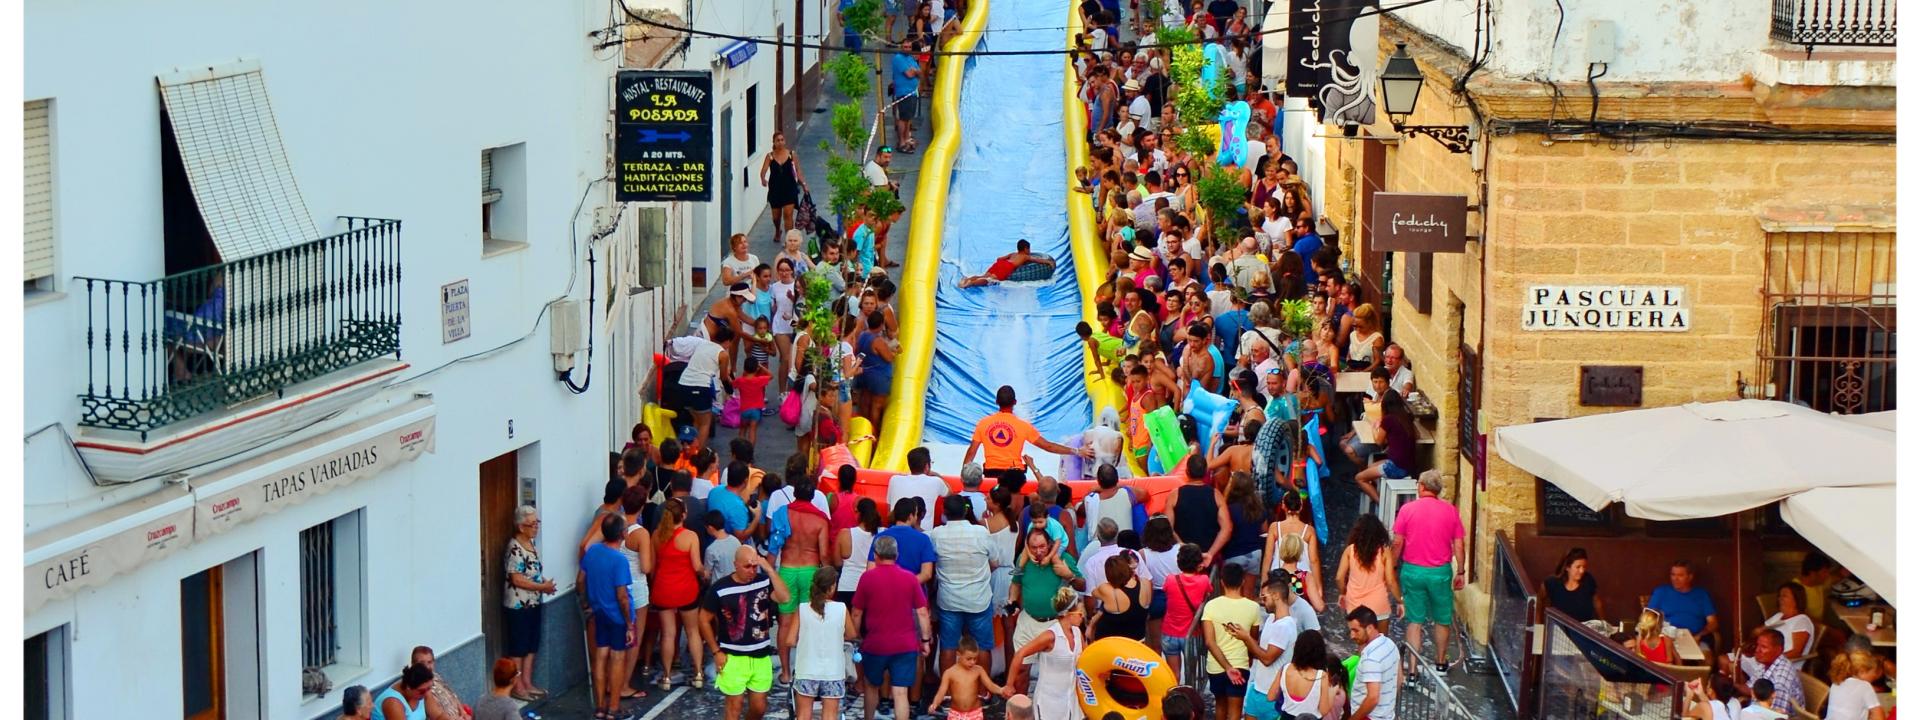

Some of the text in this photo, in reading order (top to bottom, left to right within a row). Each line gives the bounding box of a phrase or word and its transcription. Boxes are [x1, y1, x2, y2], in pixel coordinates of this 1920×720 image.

[622, 78, 706, 103] HOSTAL RESTAURANTE
[651, 94, 677, 107] LA
[629, 108, 699, 121] POSADA
[623, 163, 705, 171] TERRAZA BAR
[624, 173, 704, 182] HABITACIONES
[624, 183, 704, 192] CLIMATIZADAS
[1392, 212, 1448, 238] feduchy
[1534, 288, 1678, 306] PASCUAL
[1525, 309, 1685, 328] JUNQUERA
[262, 445, 378, 503] TAPAS VARIADAS
[45, 549, 90, 589] CAFÉ
